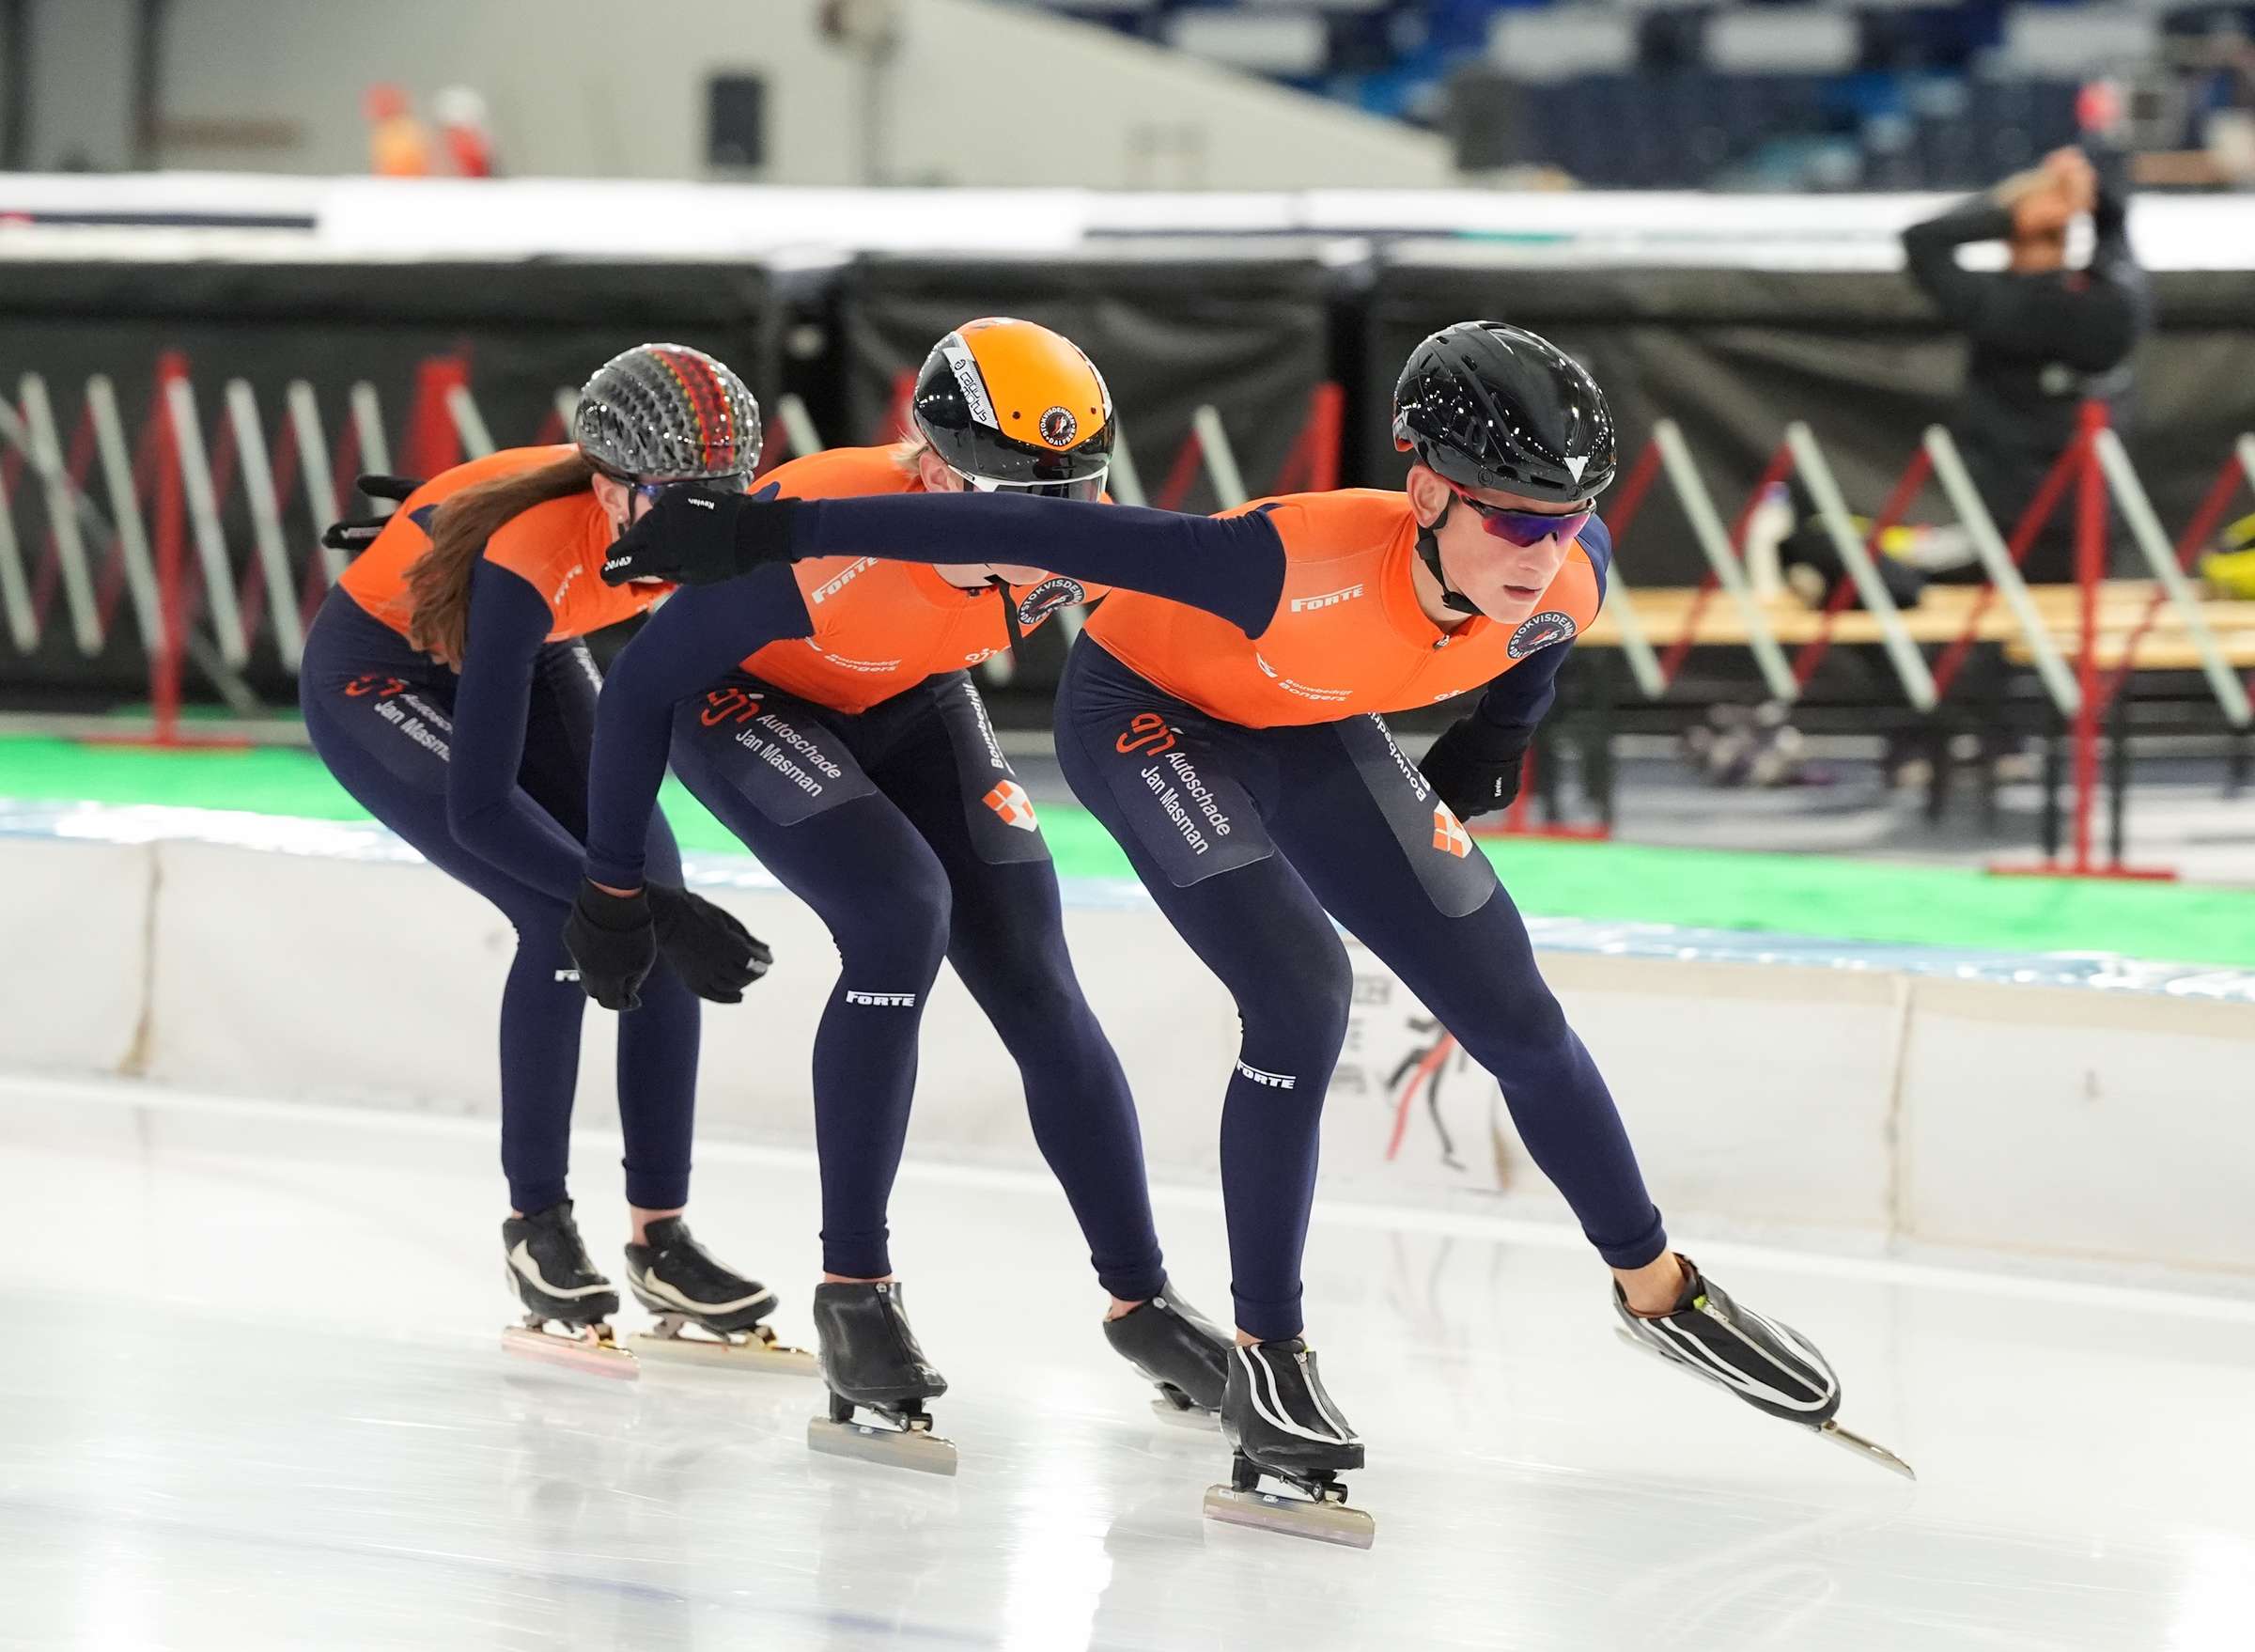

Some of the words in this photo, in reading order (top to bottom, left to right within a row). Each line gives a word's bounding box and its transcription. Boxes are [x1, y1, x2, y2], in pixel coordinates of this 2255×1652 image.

[1291, 583, 1365, 613] FORTE
[374, 700, 406, 725] Jan
[736, 729, 764, 752] Jan
[759, 743, 823, 797] Masman
[756, 714, 842, 779] Autoschade
[1141, 765, 1166, 795] Jan
[1159, 787, 1209, 855] Masman
[1165, 752, 1231, 835] Autoschade
[846, 990, 916, 1007] FORTE
[1236, 1058, 1297, 1089] FORTE
